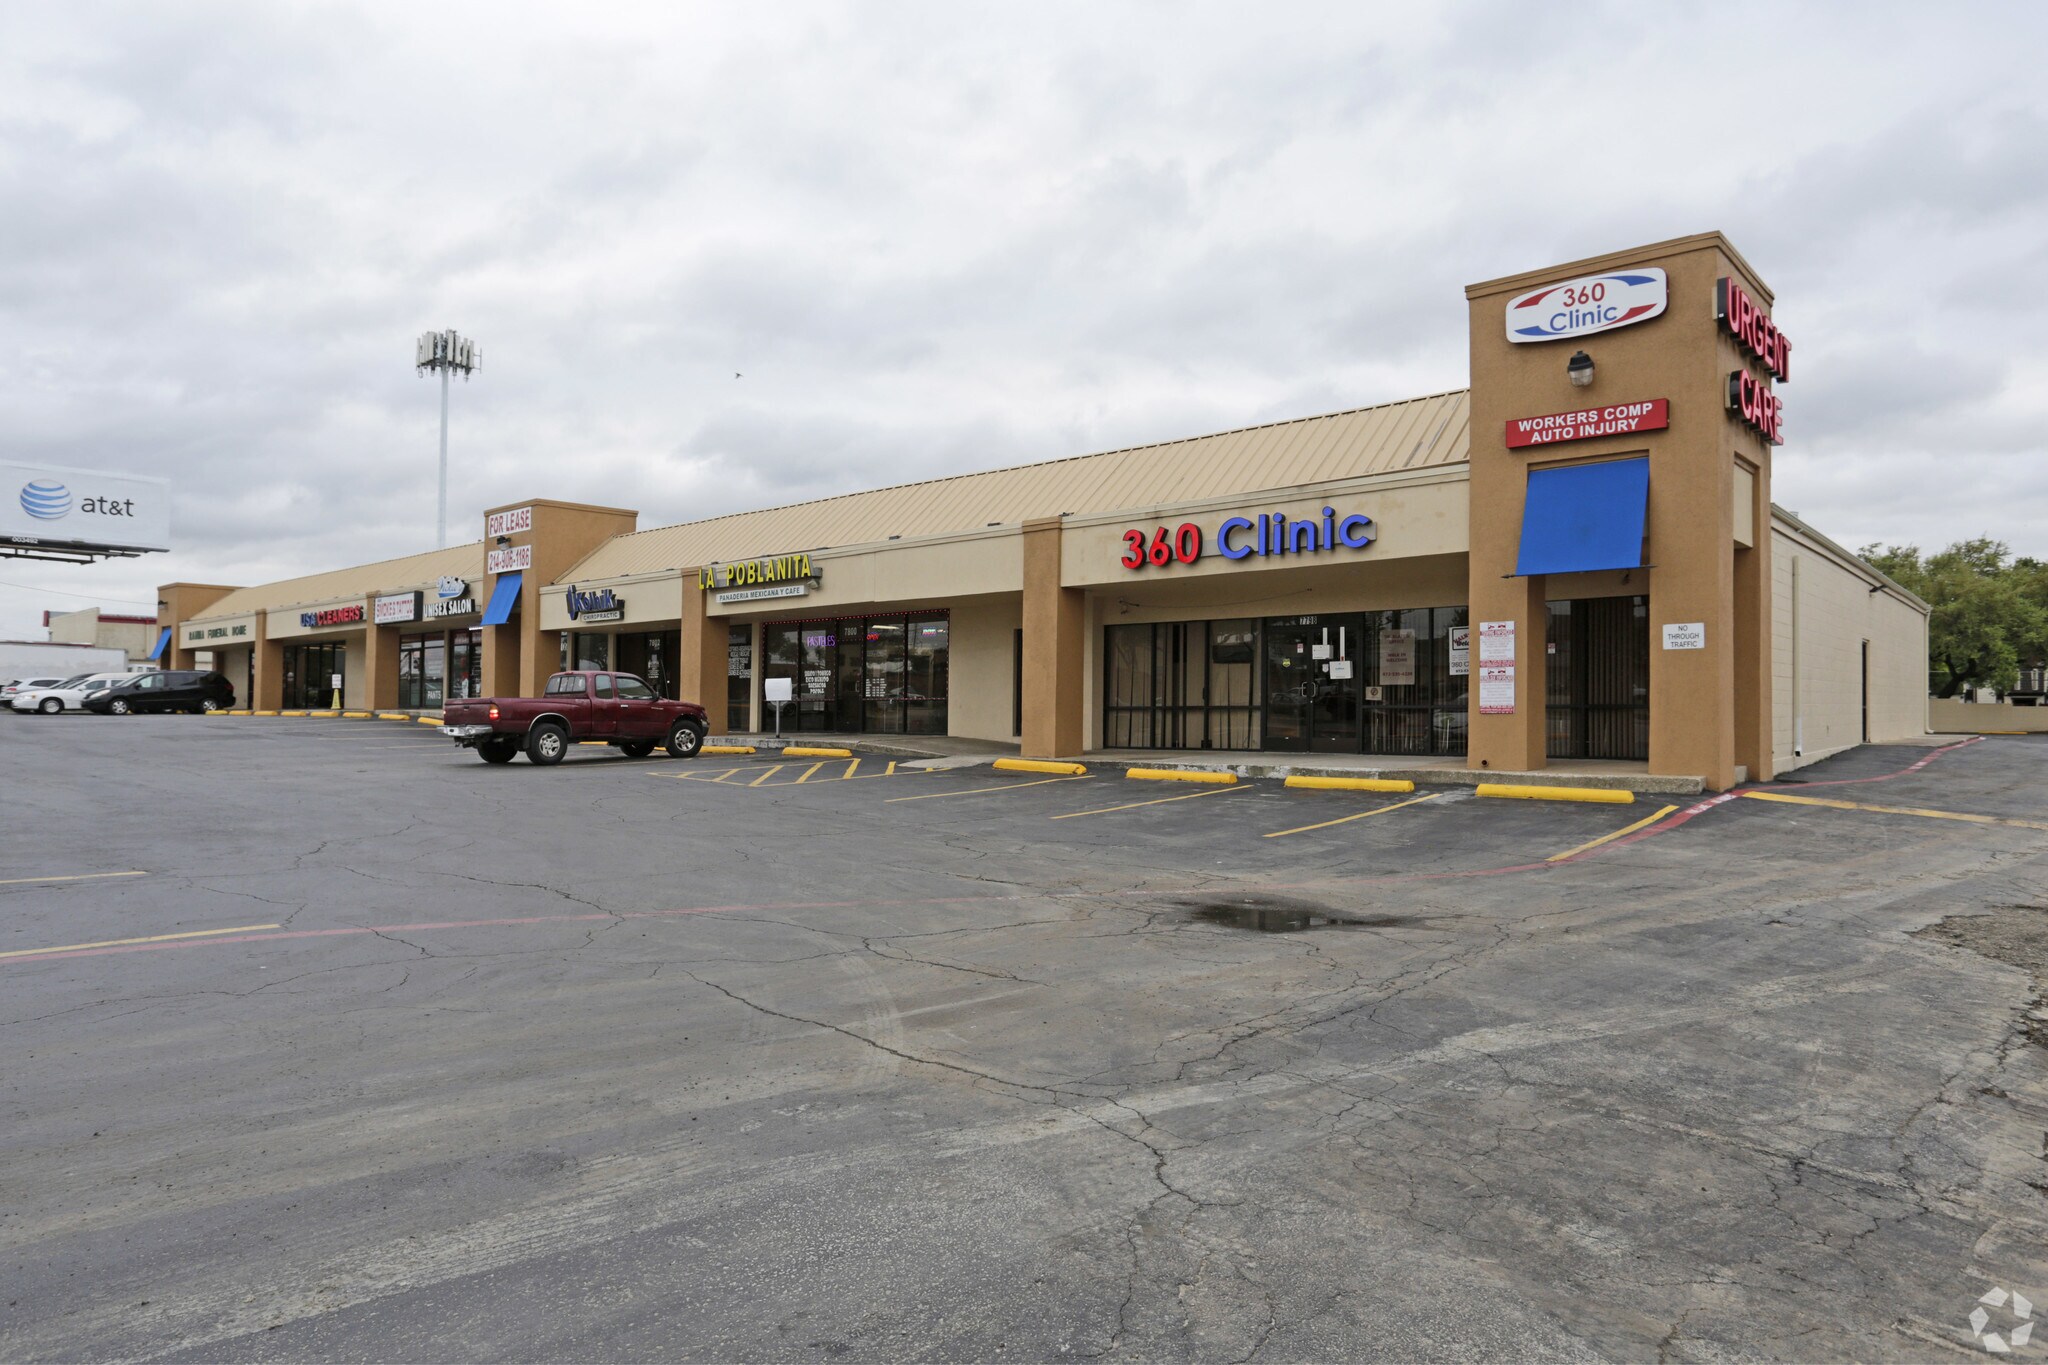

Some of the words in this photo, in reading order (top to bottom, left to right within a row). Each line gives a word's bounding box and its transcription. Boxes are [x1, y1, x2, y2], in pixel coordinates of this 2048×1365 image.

[1562, 282, 1606, 308] 360
[1549, 304, 1618, 332] Clinic
[1725, 276, 1792, 383] URGENT
[1518, 410, 1598, 432] WORKERS
[1603, 402, 1653, 420] COMP
[1738, 368, 1784, 446] CARE
[1530, 427, 1575, 444] AUTO
[1579, 417, 1639, 437] INJURY
[81, 496, 135, 518] at&t
[489, 514, 504, 536] FOR
[505, 509, 530, 532] LEASE
[1121, 522, 1202, 570] 360
[1216, 505, 1374, 560] Clinic
[698, 567, 715, 590] LA
[726, 554, 812, 586] POBLANITA
[719, 591, 749, 602] PANADERIA
[750, 588, 779, 598] MEXICANA
[785, 586, 800, 595] CAFE
[300, 612, 317, 627] USA
[317, 604, 361, 625] CLEANERS
[423, 601, 448, 618] UNISEX
[448, 598, 472, 615] SALON
[583, 611, 618, 621] CHIROPRACTIC
[231, 624, 247, 637] HOME
[1299, 615, 1318, 626] 7798
[1678, 624, 1689, 632] NO
[806, 634, 836, 647] PASTELES
[1667, 632, 1700, 640] THROUGH
[1670, 640, 1698, 648] TRAFFIC
[427, 690, 442, 700] PANTS
